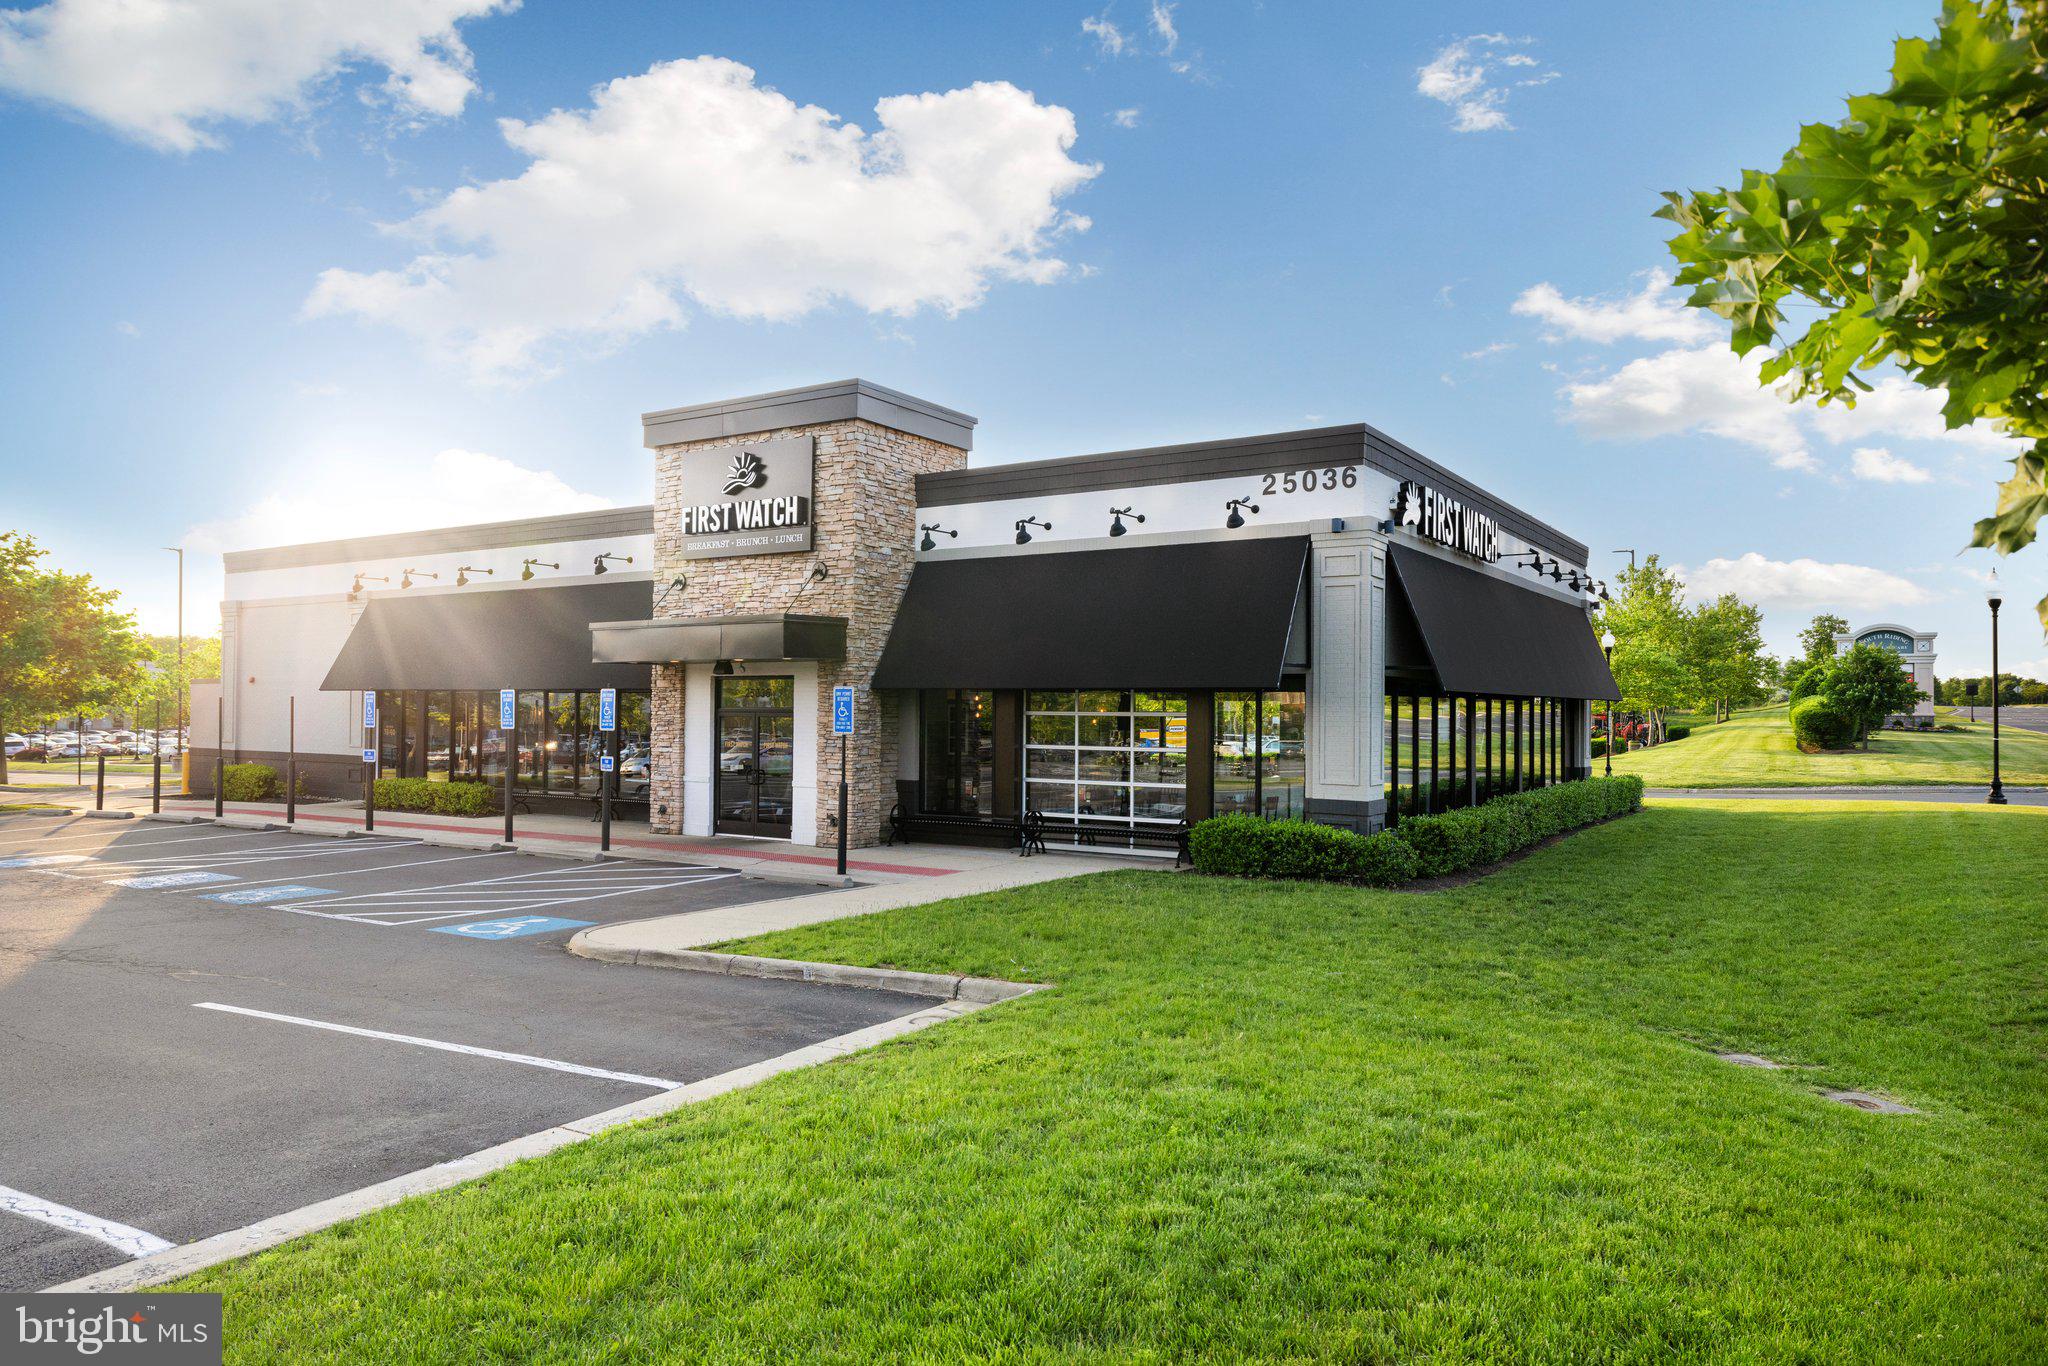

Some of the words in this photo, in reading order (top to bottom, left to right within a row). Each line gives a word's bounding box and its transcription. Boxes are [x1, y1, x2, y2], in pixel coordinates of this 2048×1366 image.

[1262, 466, 1357, 495] 25036
[681, 503, 732, 534] FIRST
[735, 496, 798, 529] WATCH
[1424, 486, 1461, 547] FIRST
[1462, 506, 1499, 564] WATCH
[687, 540, 730, 551] BREAKFAST
[736, 537, 769, 547] BRUNCH
[775, 533, 803, 543] LUNCH
